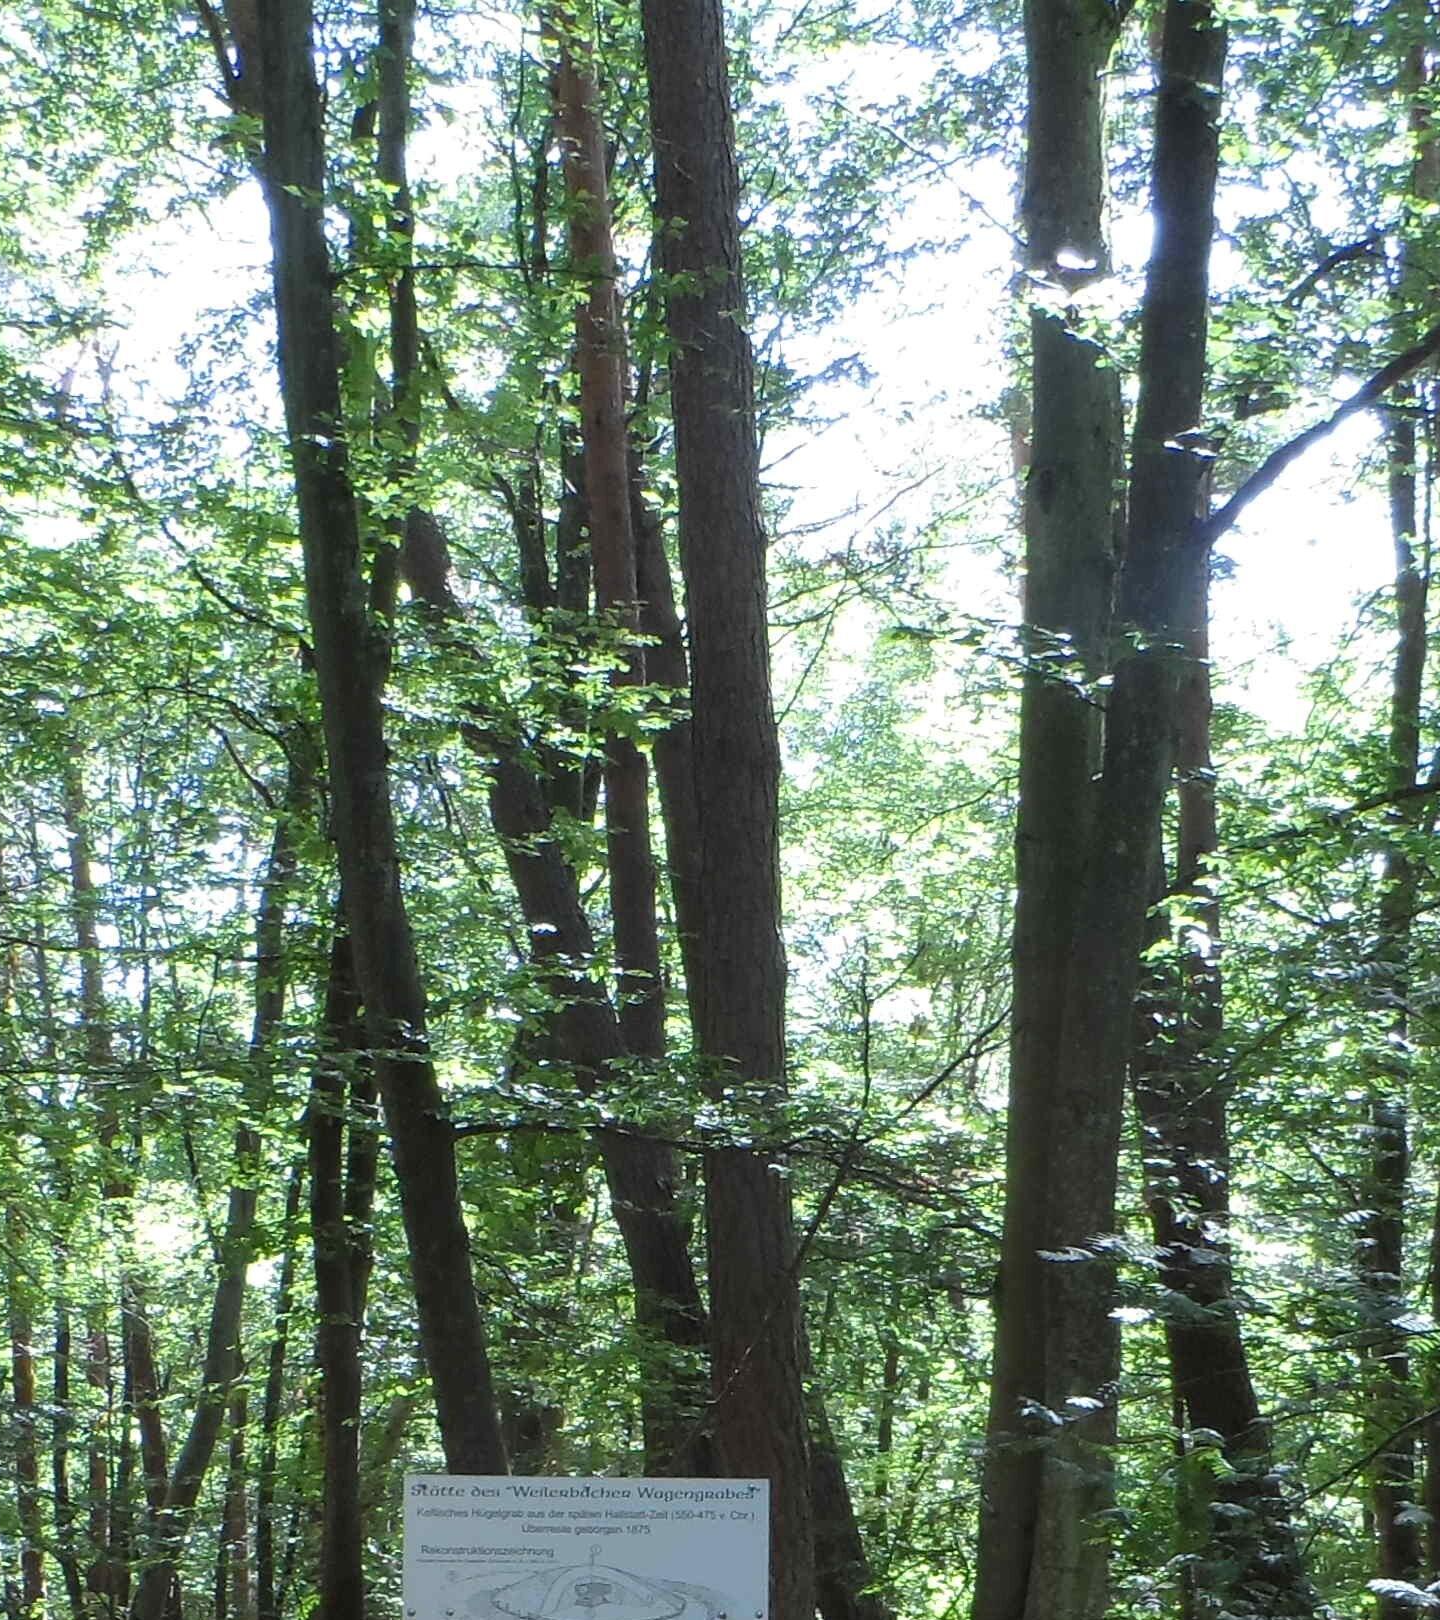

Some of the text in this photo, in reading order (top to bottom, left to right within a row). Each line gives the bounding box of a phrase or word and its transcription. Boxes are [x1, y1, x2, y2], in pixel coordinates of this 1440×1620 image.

[470, 1486, 500, 1497] des
[527, 1510, 545, 1519] aus
[548, 1508, 564, 1519] der
